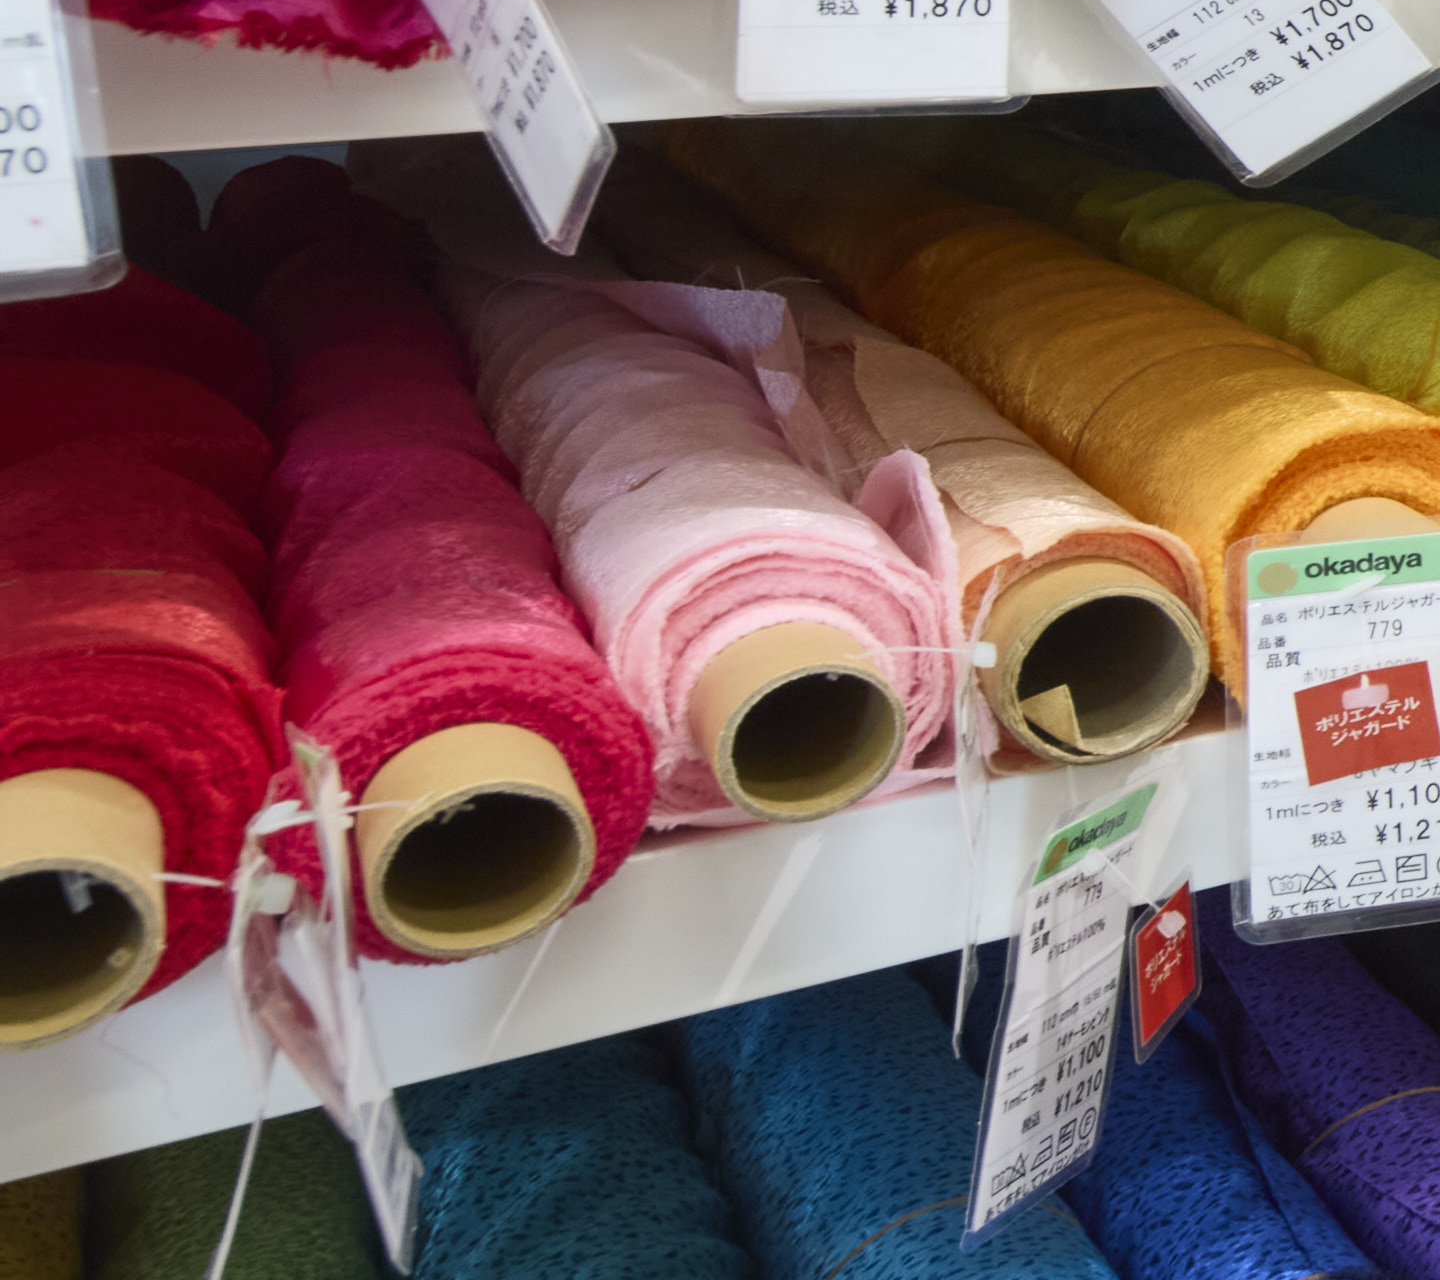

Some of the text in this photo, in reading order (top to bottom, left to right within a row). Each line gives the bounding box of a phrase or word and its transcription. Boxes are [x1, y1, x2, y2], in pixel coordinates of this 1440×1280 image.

[818, 0, 859, 16] 税込
[1290, 12, 1376, 72] ¥1,870
[1304, 548, 1422, 579] okadaya
[1367, 618, 1403, 641] 779
[1315, 696, 1421, 734] ポリエステル
[1329, 714, 1412, 746] ジャガード
